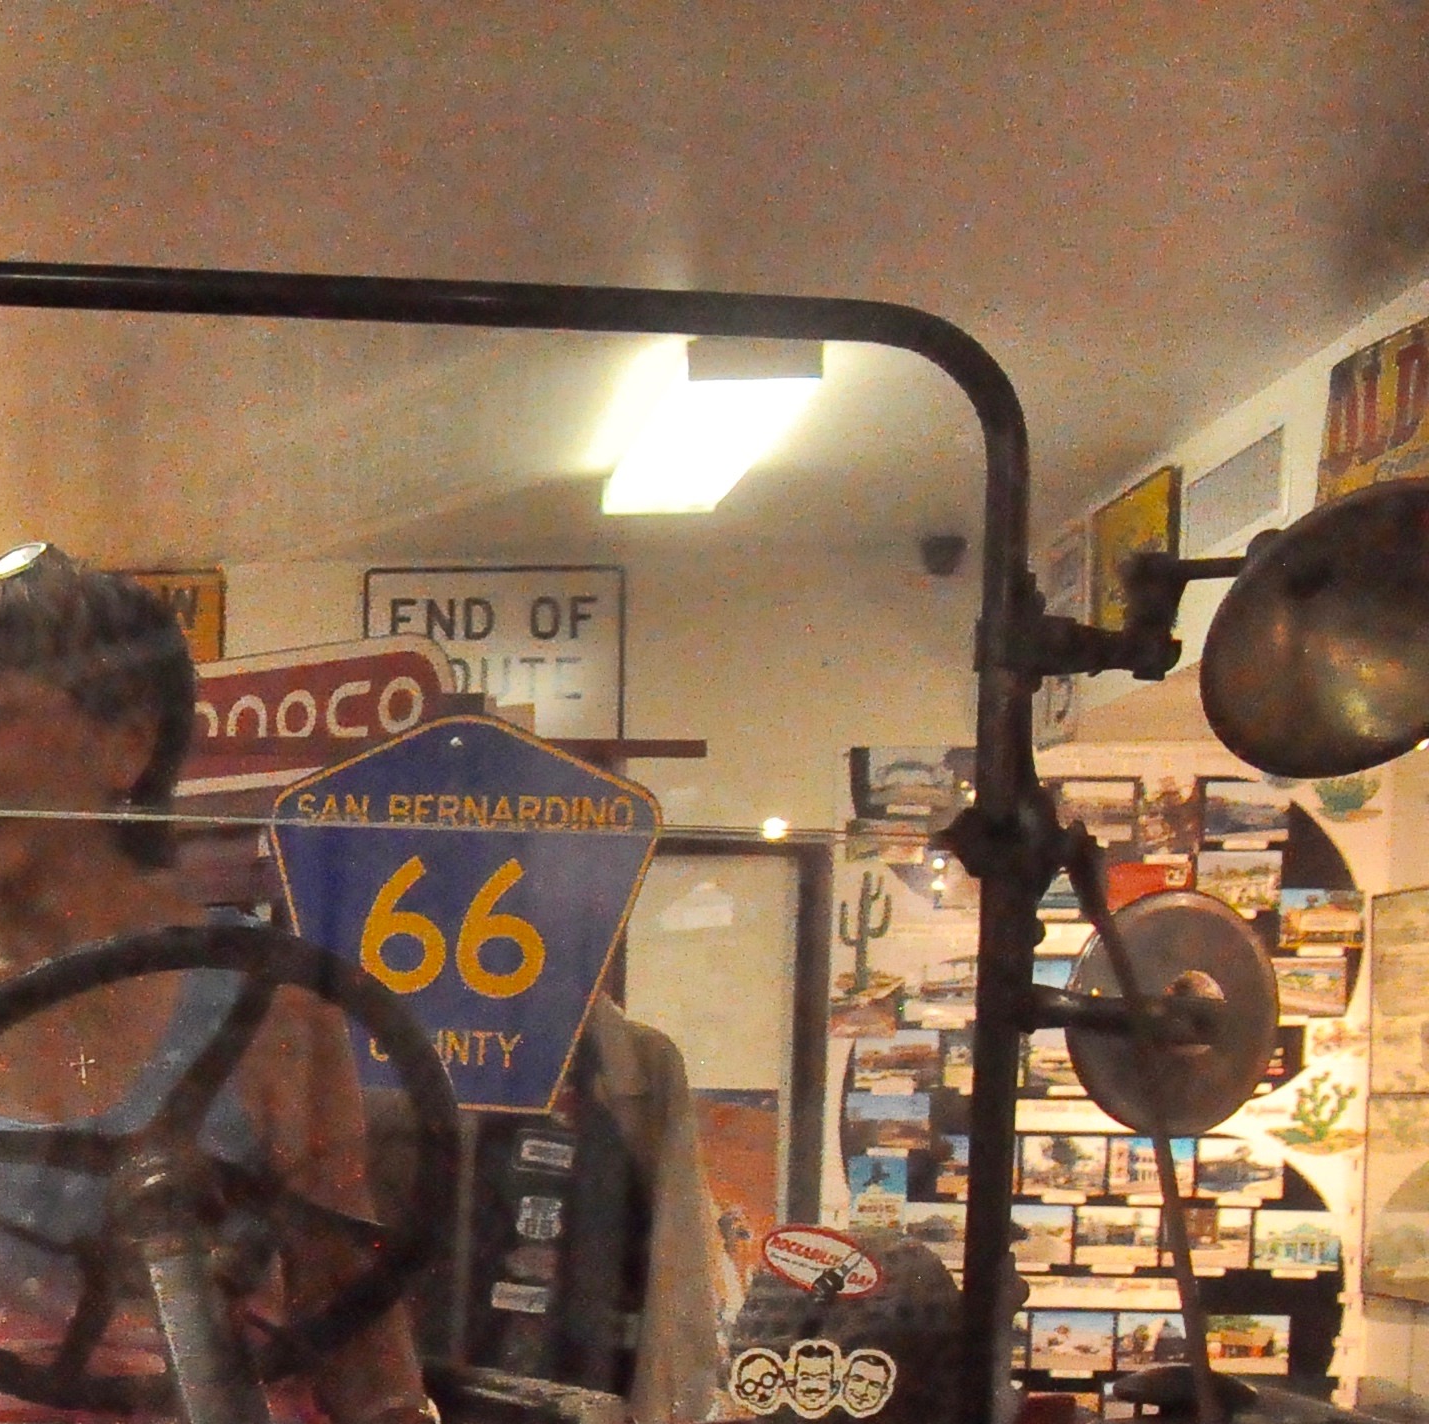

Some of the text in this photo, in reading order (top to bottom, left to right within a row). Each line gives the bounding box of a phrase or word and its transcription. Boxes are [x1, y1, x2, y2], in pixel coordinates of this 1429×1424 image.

[389, 595, 599, 641] END OF
[296, 793, 636, 832] SAN BERNARDINO
[359, 854, 546, 999] 66
